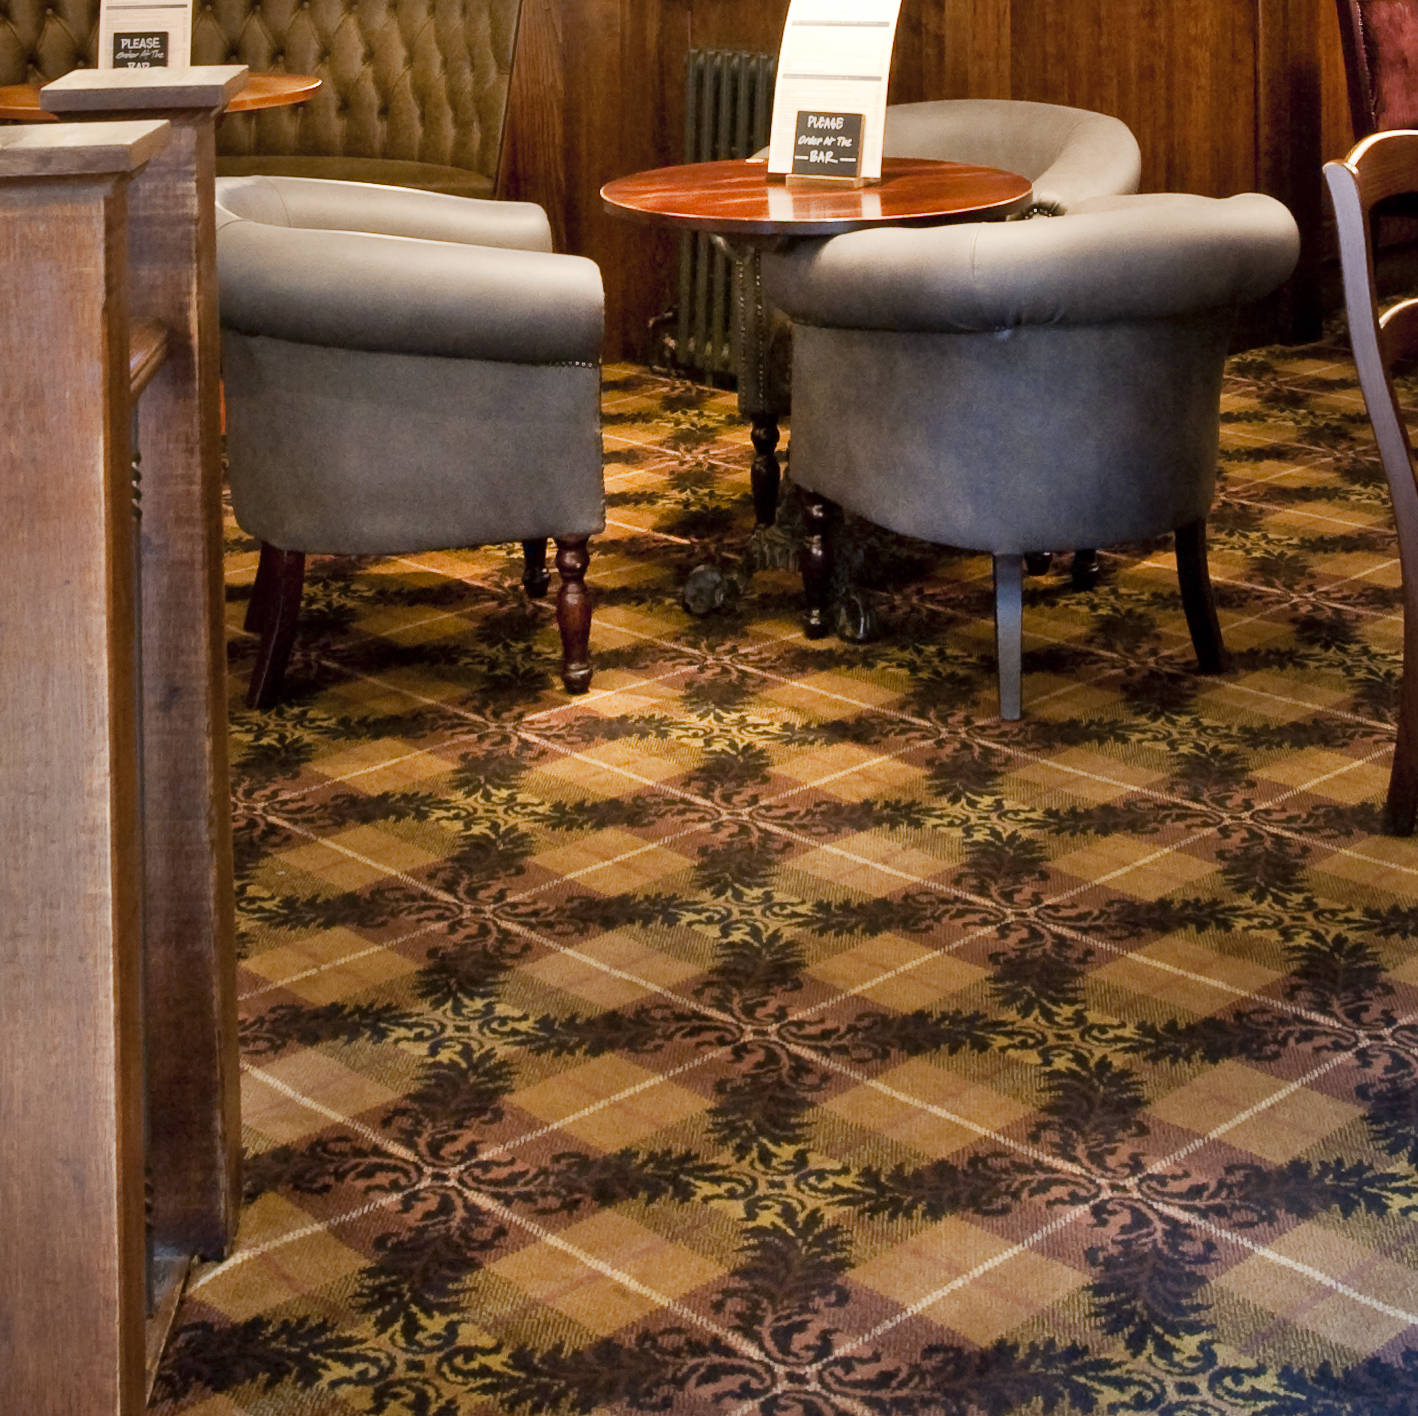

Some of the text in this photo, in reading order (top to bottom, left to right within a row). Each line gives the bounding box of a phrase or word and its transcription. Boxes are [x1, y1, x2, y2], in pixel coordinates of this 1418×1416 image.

[120, 37, 161, 50] PLEASE
[807, 115, 845, 130] PLEASE
[798, 135, 853, 148] Order At The
[809, 149, 839, 164] BAR
